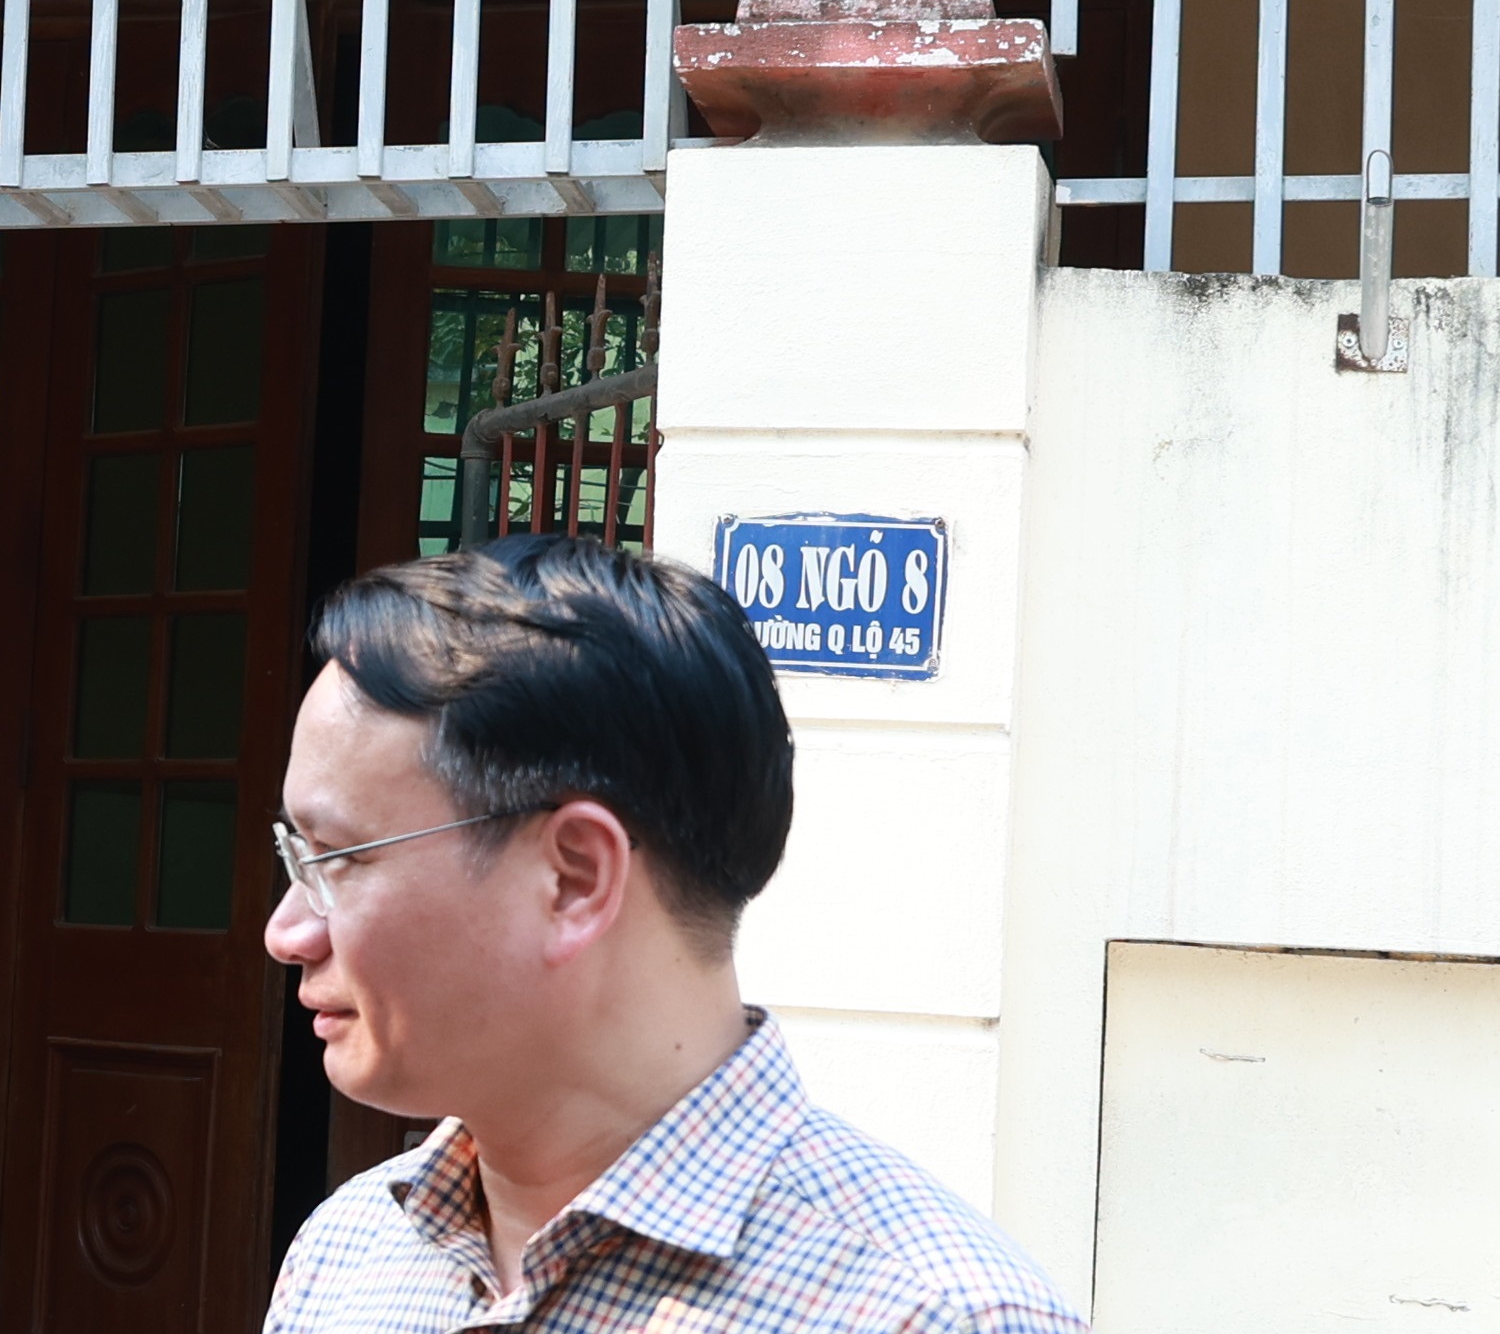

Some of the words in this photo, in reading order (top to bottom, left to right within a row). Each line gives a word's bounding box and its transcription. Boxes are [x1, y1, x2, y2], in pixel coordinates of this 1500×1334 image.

[735, 543, 785, 609] 08
[796, 529, 888, 613] NGÕ
[902, 549, 929, 615] 8
[753, 614, 821, 651] ƯỜNG
[888, 627, 921, 655] 45
